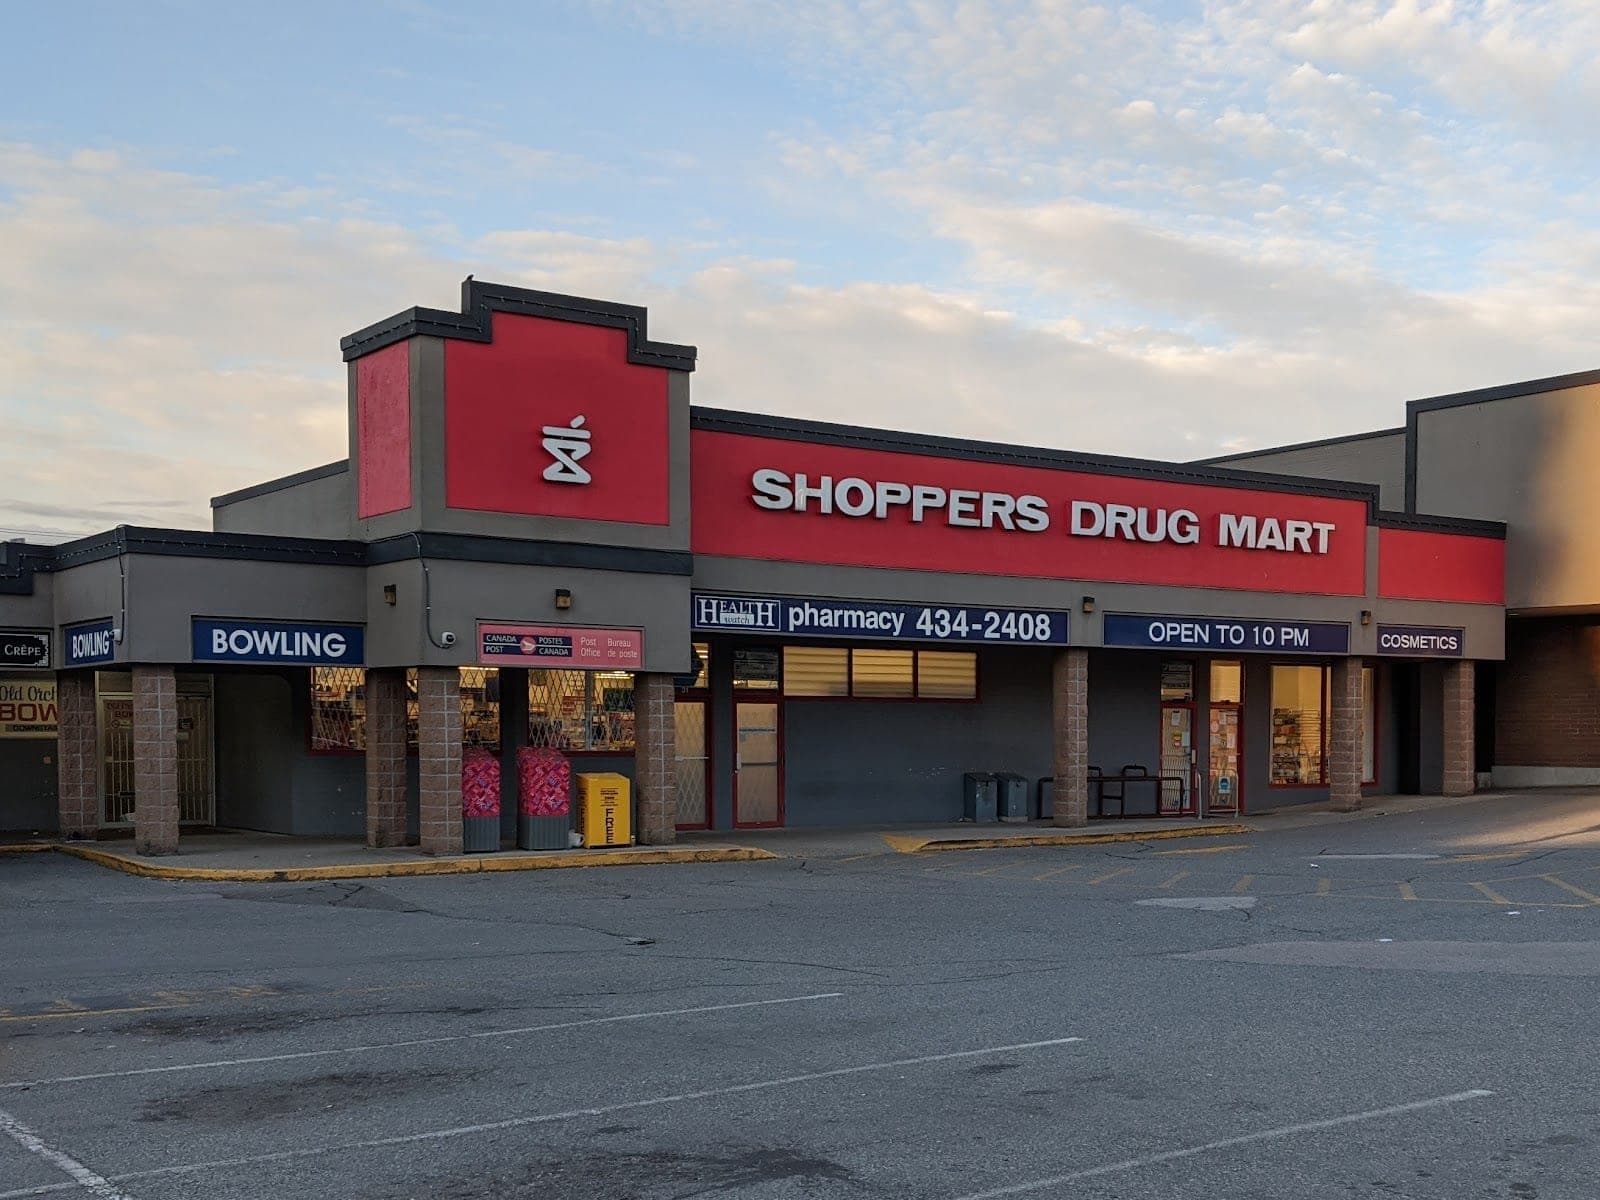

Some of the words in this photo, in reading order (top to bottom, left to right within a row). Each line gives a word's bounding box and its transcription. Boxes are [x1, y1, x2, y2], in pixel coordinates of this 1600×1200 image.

[751, 468, 1050, 532] SHOPPERS
[1070, 500, 1201, 544] DRUG
[1217, 513, 1336, 554] MART
[697, 599, 778, 627] HEALTH
[788, 602, 906, 637] pharmacy
[915, 607, 1051, 641] 434-2408
[725, 615, 751, 625] watch
[485, 634, 517, 643] CANADA
[1148, 621, 1210, 644] OPEN
[1215, 624, 1246, 645] TO
[1252, 626, 1275, 646] 10
[1280, 627, 1310, 647] PM
[72, 630, 110, 659] BOWLING
[212, 628, 347, 658] BOWLING
[538, 636, 564, 646] POSTES
[580, 636, 598, 647] Post
[607, 637, 632, 648] Bureau
[1381, 633, 1458, 650] COSMETICS
[485, 645, 504, 654] POST
[538, 647, 569, 656] CANADA
[580, 647, 601, 658] Office
[607, 648, 617, 658] de
[619, 648, 638, 659] poste
[0, 685, 22, 702] Old
[605, 808, 615, 844] FREE
